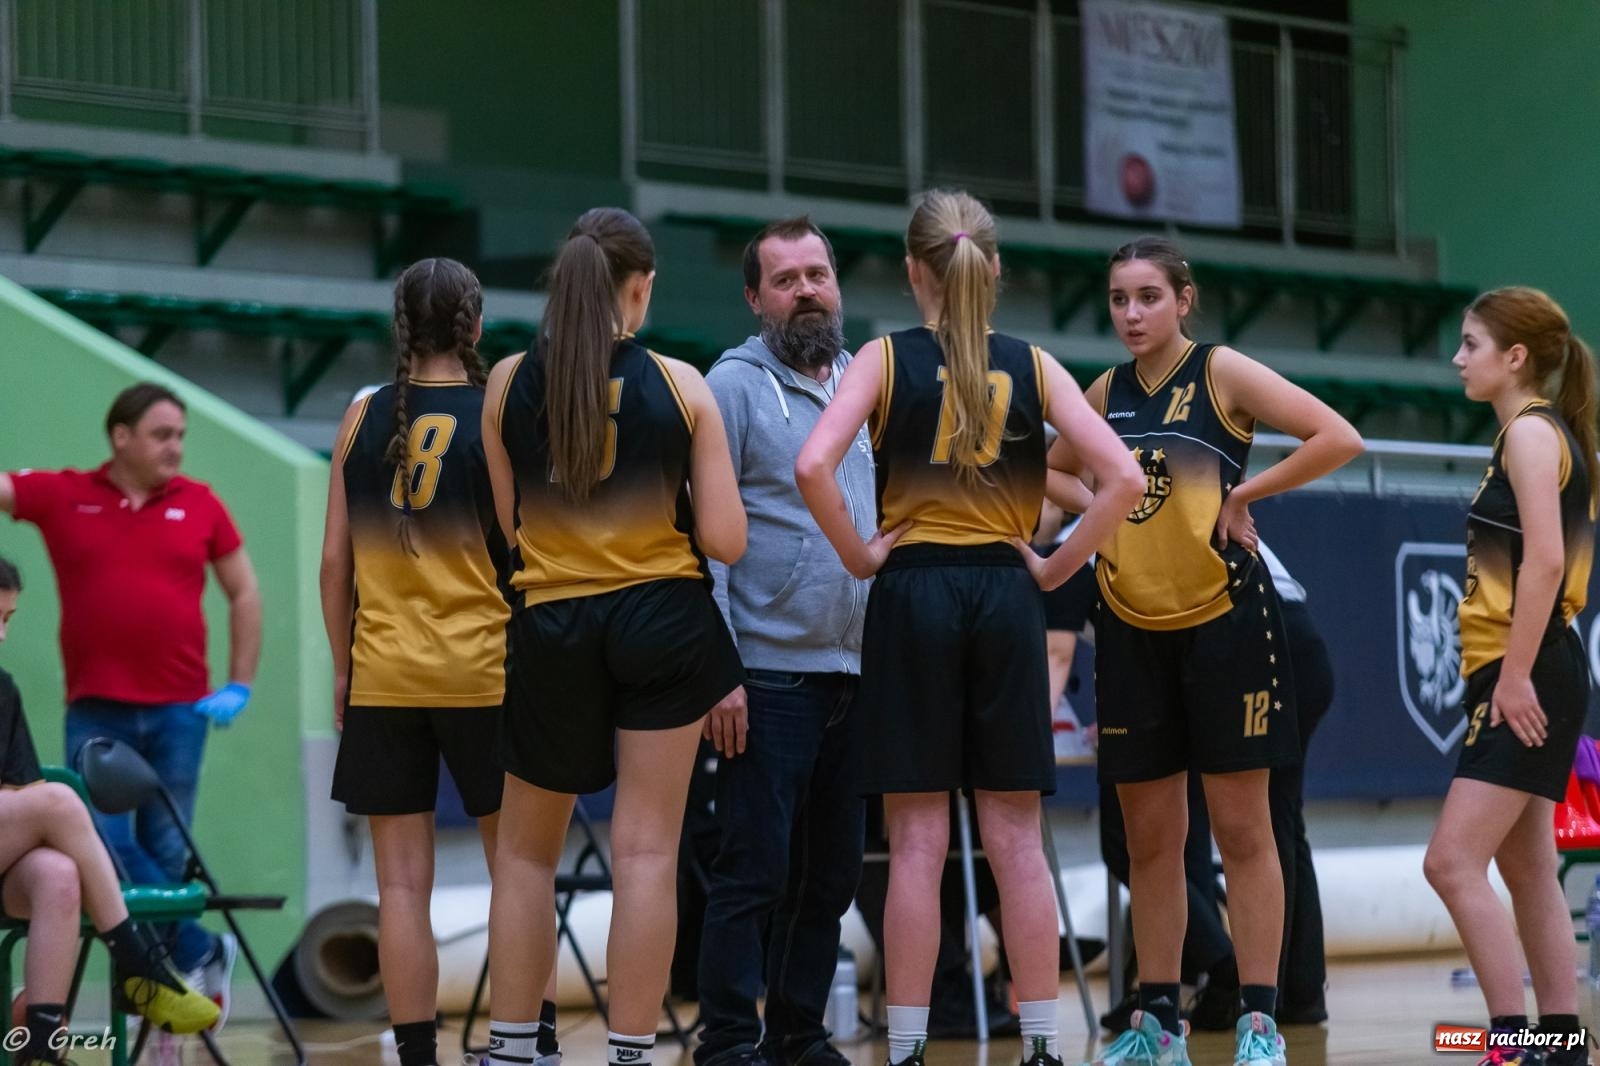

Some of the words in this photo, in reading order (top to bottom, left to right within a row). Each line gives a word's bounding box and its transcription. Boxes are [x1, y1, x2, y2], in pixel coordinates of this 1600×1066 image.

[1162, 382, 1196, 425] 12
[391, 413, 457, 510] 8
[1243, 690, 1270, 737] 12
[616, 1048, 643, 1057] NIKE
